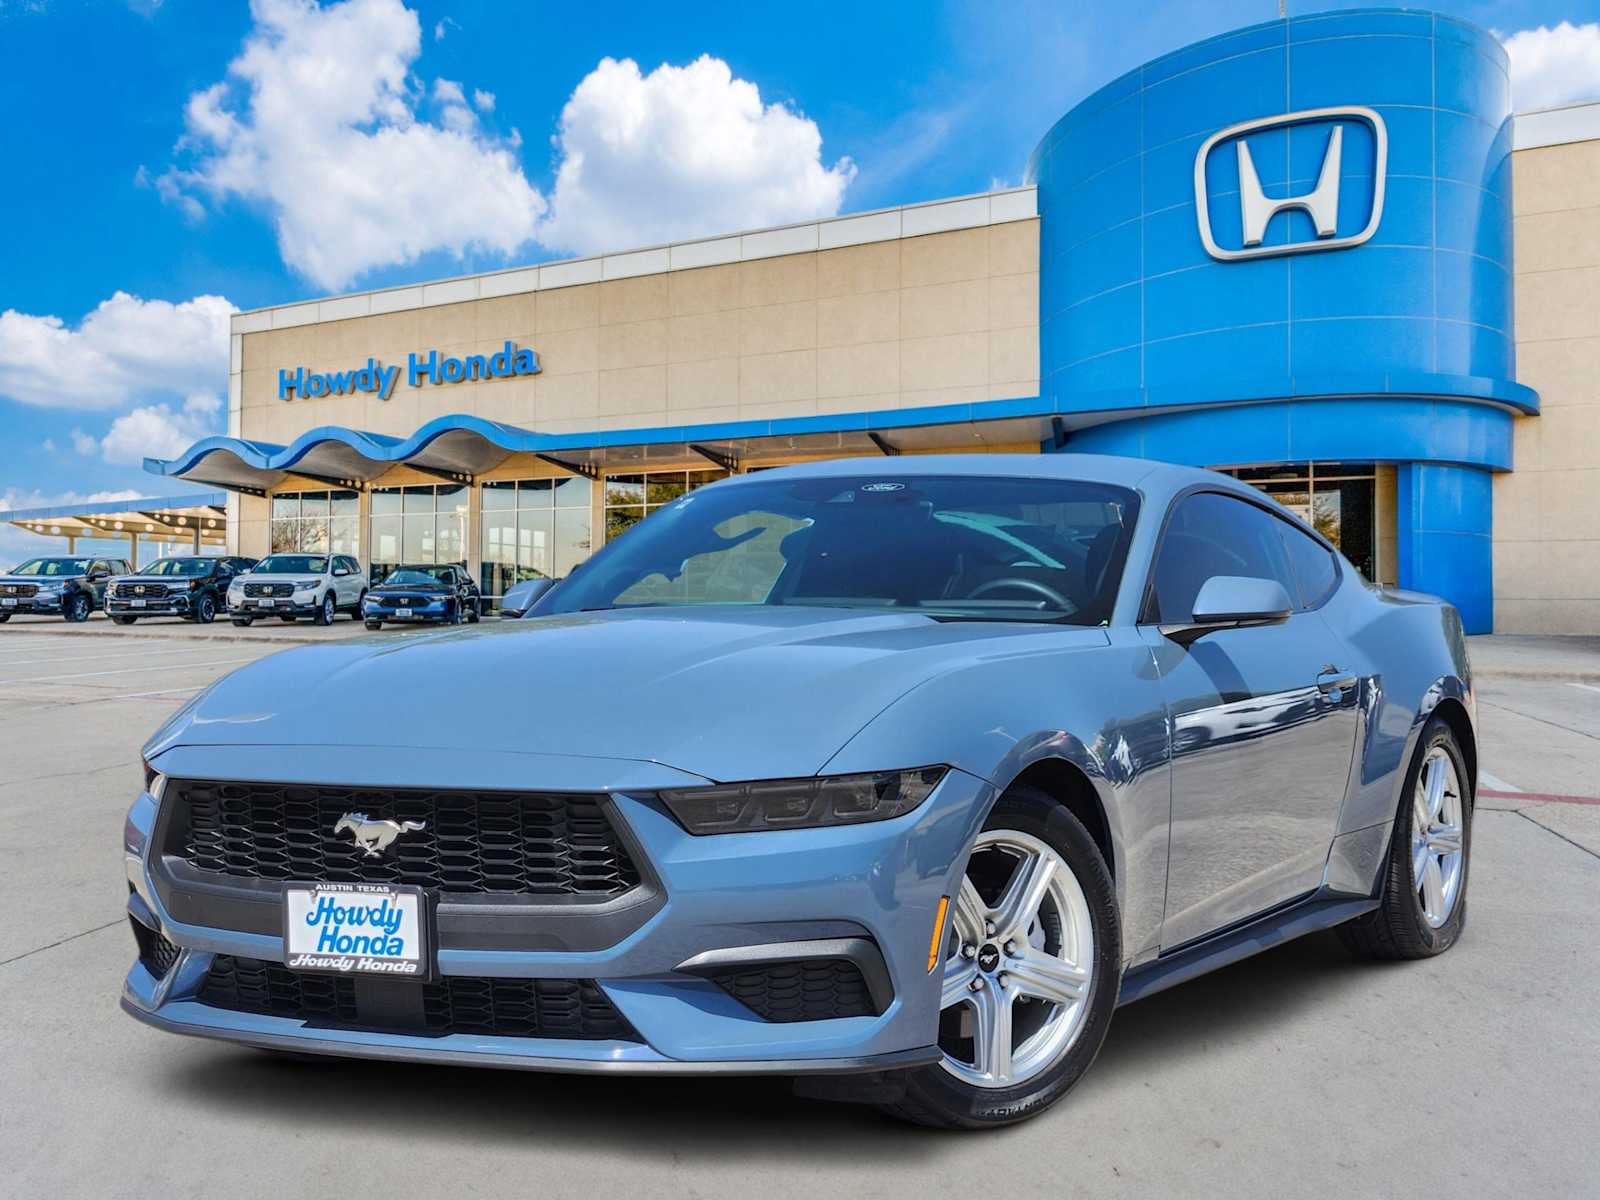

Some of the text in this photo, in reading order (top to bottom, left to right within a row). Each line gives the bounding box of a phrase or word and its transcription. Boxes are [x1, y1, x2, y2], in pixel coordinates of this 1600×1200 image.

[278, 340, 542, 400] Howdy Honda
[315, 884, 391, 893] AUSTIN TEXAS
[306, 896, 403, 935] Howdy
[316, 926, 404, 956] Honda
[289, 954, 417, 973] Howdy Honda
